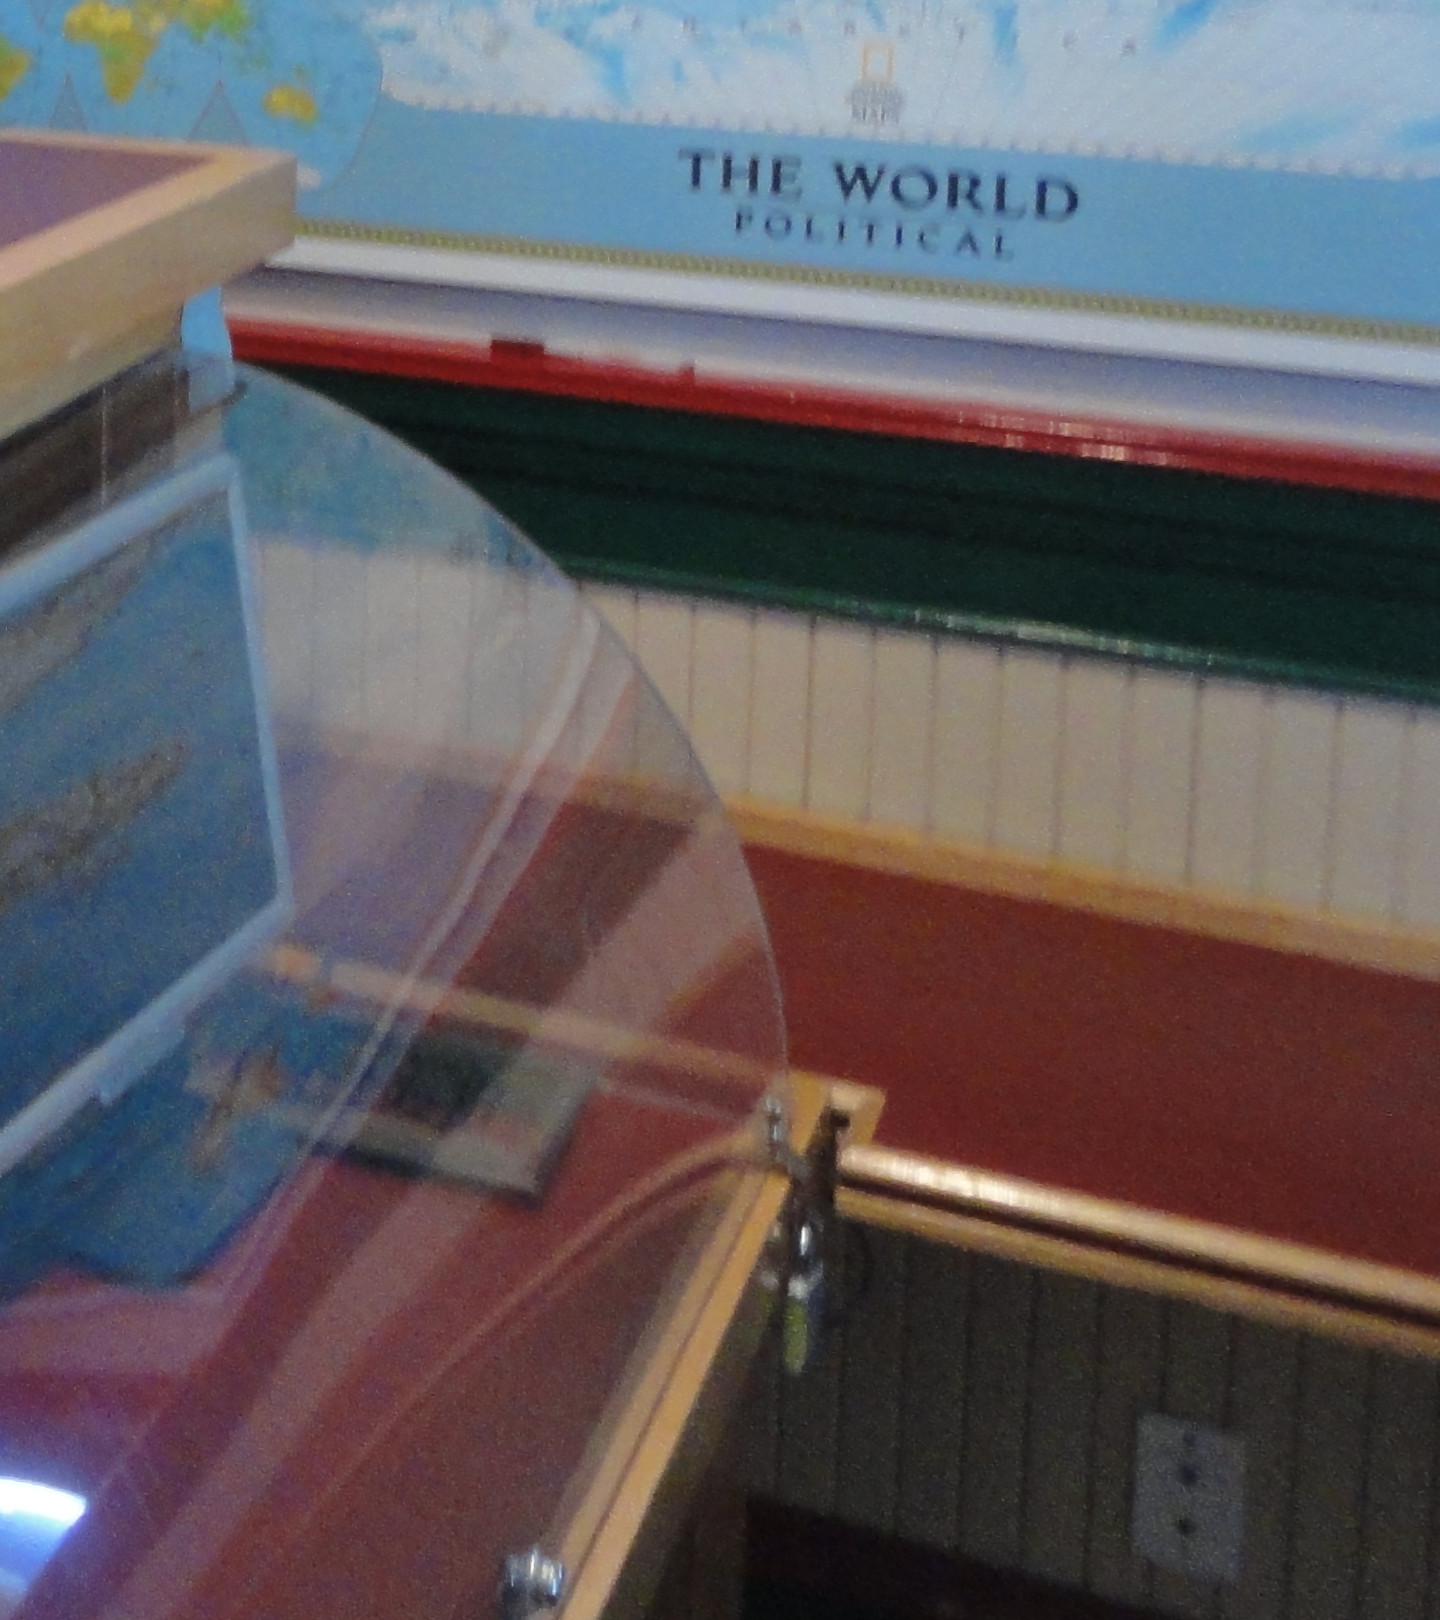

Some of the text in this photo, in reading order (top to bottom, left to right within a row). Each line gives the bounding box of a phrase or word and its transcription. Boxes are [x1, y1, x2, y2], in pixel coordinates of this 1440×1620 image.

[678, 146, 1081, 223] THE WORLD
[734, 204, 1015, 261] POLITICAL
